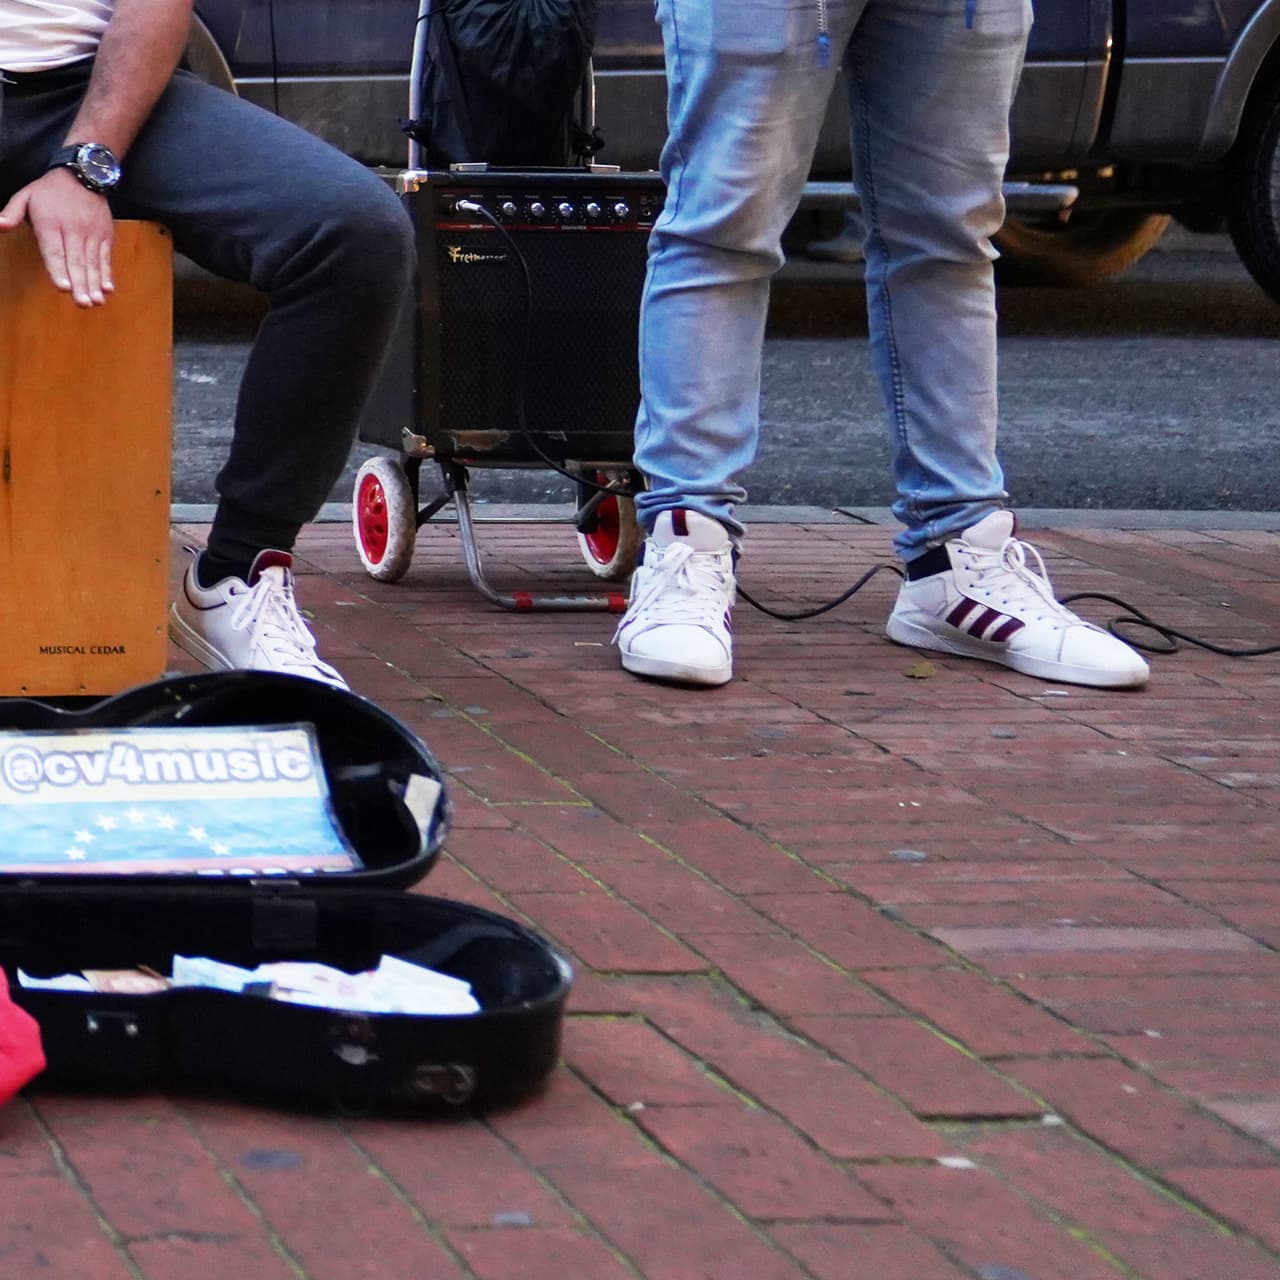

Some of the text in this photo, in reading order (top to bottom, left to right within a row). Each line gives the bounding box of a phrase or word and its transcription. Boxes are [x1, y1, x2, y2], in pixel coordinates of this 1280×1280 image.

[39, 645, 127, 655] MUSICAL CEDAR
[3, 741, 313, 793] @cv4music
